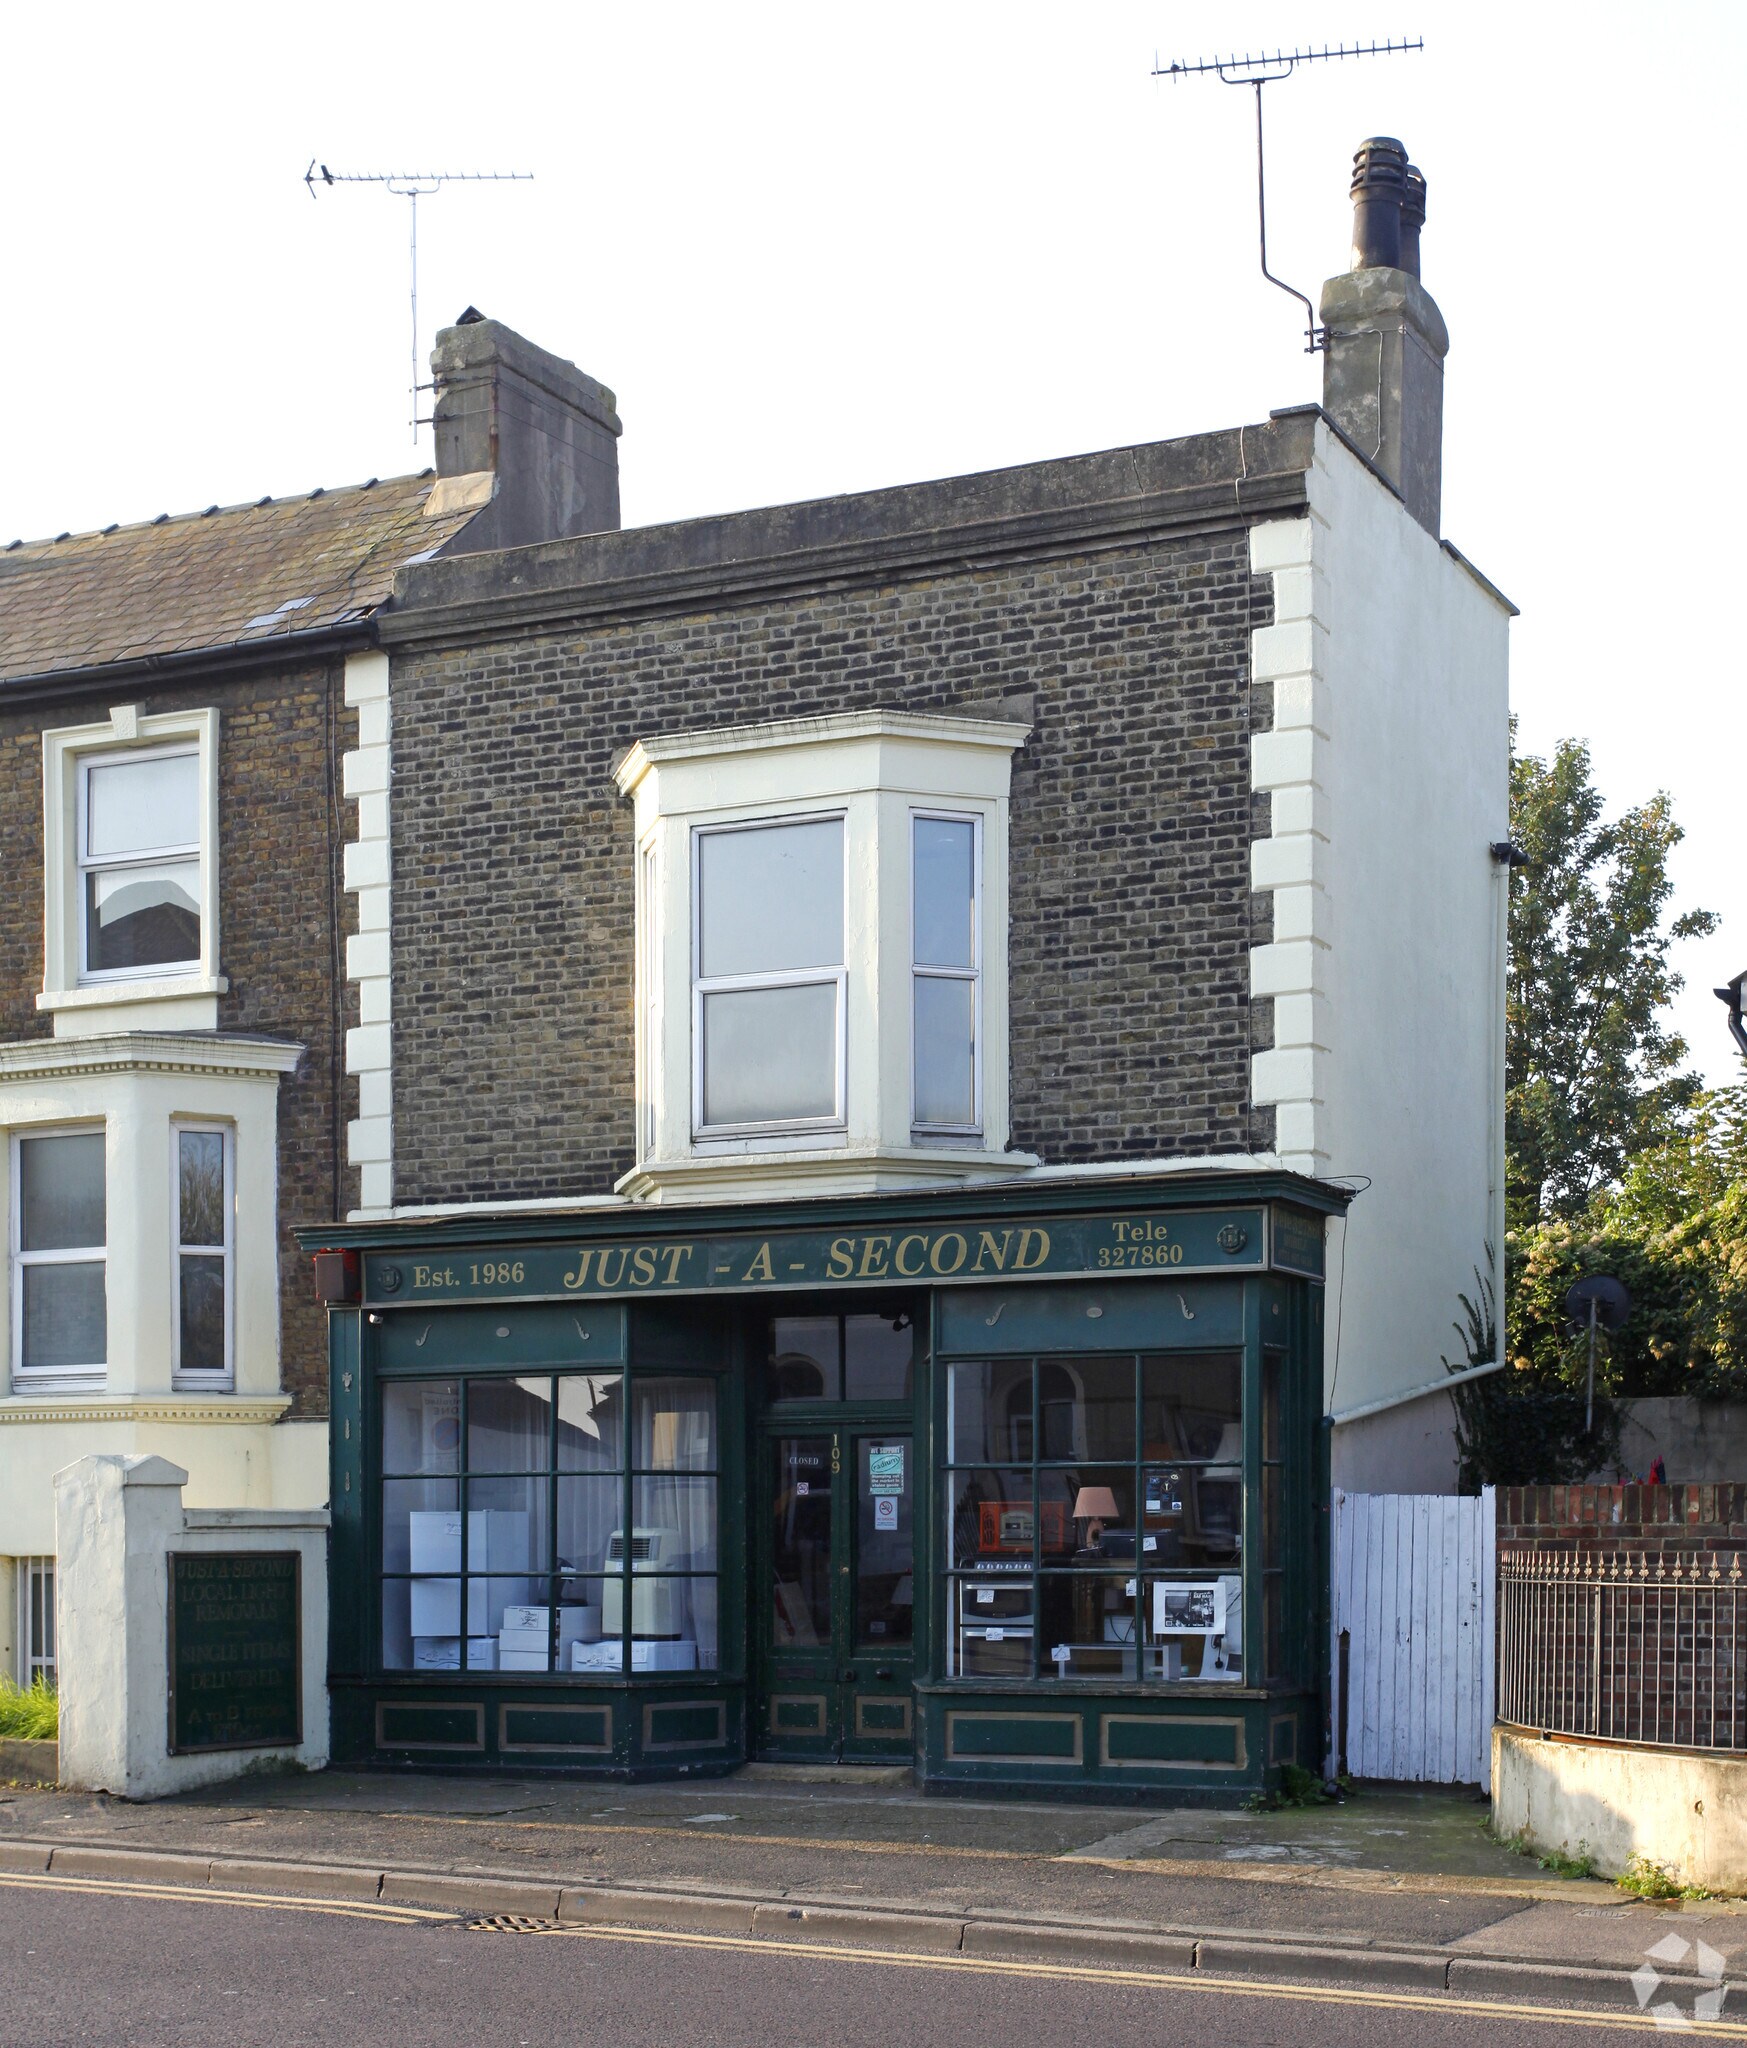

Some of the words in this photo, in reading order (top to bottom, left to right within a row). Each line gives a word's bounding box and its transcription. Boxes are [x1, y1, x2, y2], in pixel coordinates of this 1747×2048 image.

[1112, 1221, 1168, 1243] Tele
[563, 1245, 694, 1289] JUST
[825, 1228, 1052, 1280] SECOND
[1097, 1245, 1184, 1268] 327860
[413, 1265, 461, 1288] Est.
[470, 1262, 525, 1286] 1986
[789, 1456, 819, 1465] CLOSED
[873, 1457, 898, 1470] radium
[182, 1583, 238, 1603] LOCAL
[196, 1601, 278, 1622] REMOVALS
[181, 1643, 238, 1664] SINGLE
